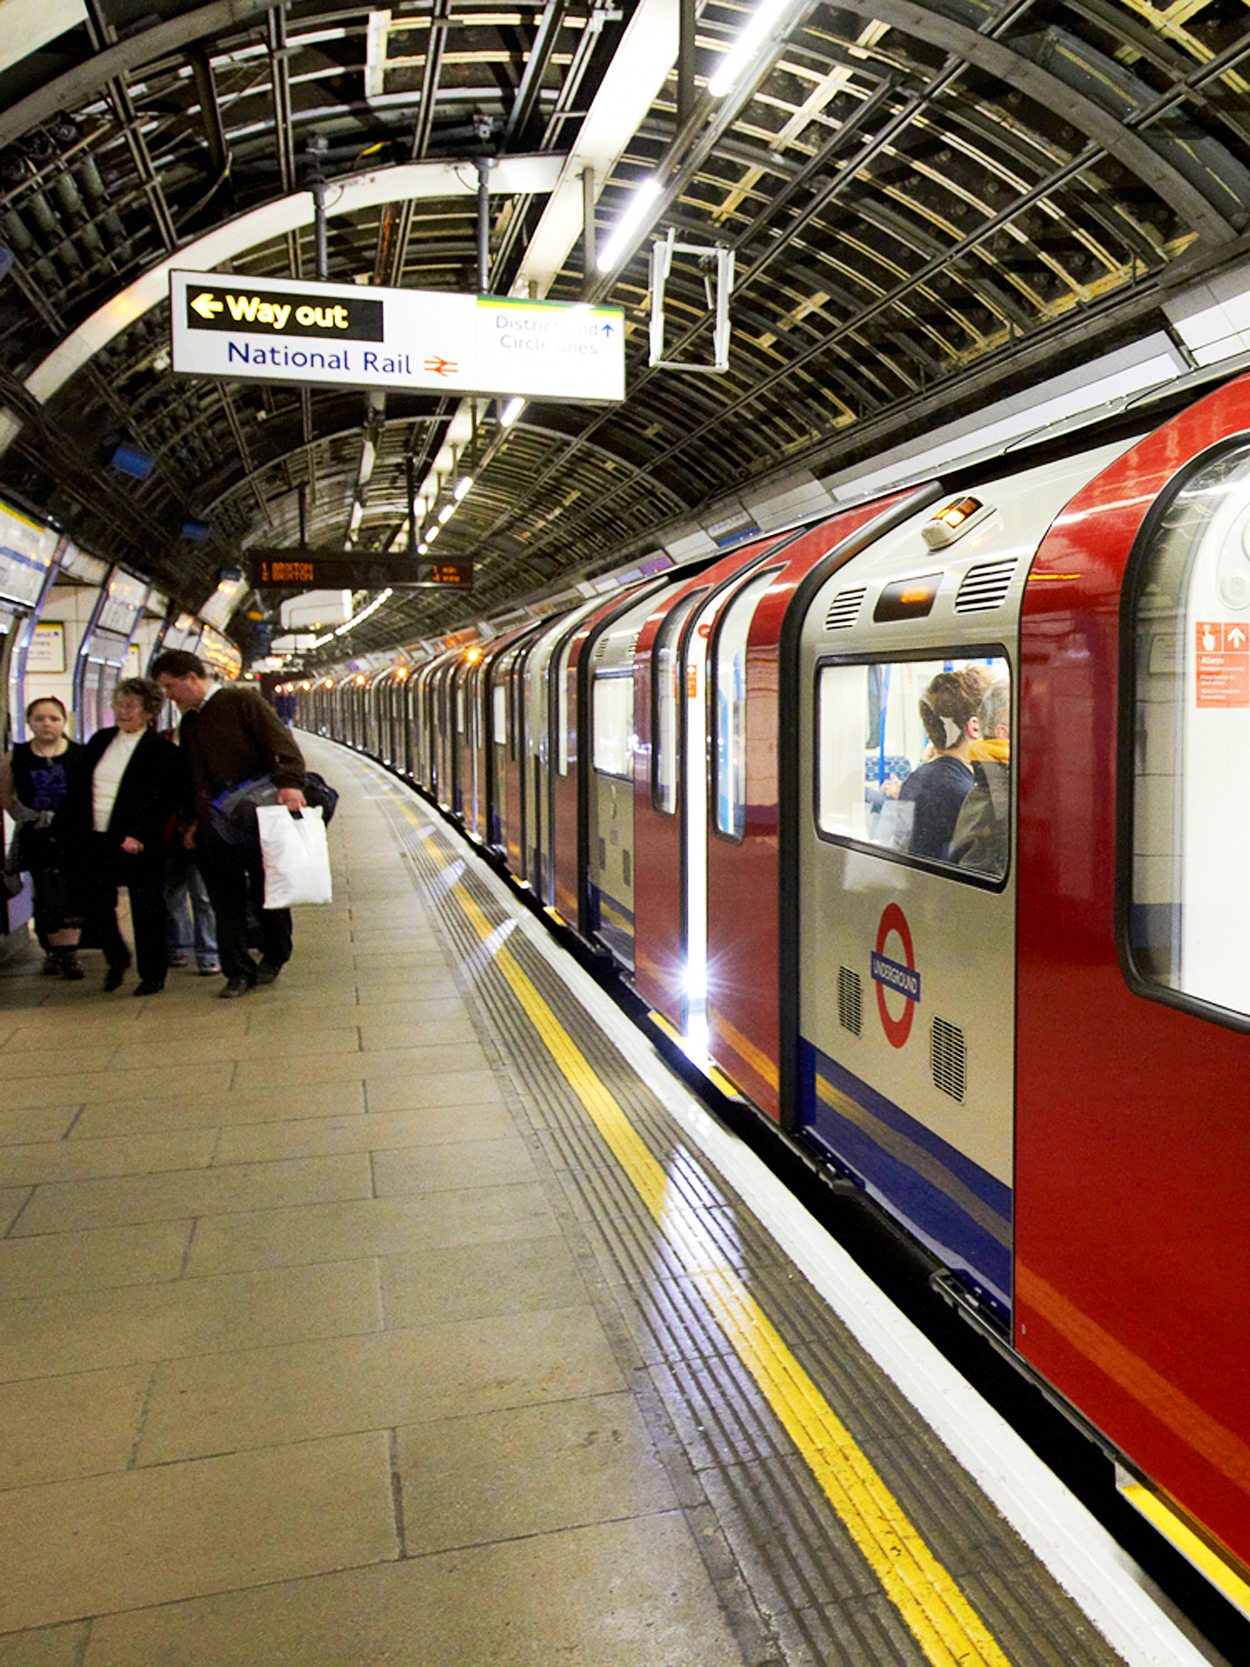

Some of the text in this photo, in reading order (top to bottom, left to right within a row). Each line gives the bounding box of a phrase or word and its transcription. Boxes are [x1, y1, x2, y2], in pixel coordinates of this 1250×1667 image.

[225, 294, 349, 330] Way out
[496, 314, 560, 333] Distric
[228, 341, 412, 375] National Rail
[271, 562, 314, 571] BRIXTON
[271, 571, 314, 581] BRIXTON
[1200, 656, 1224, 664] Alarm
[873, 958, 917, 994] UNDERGROUND
